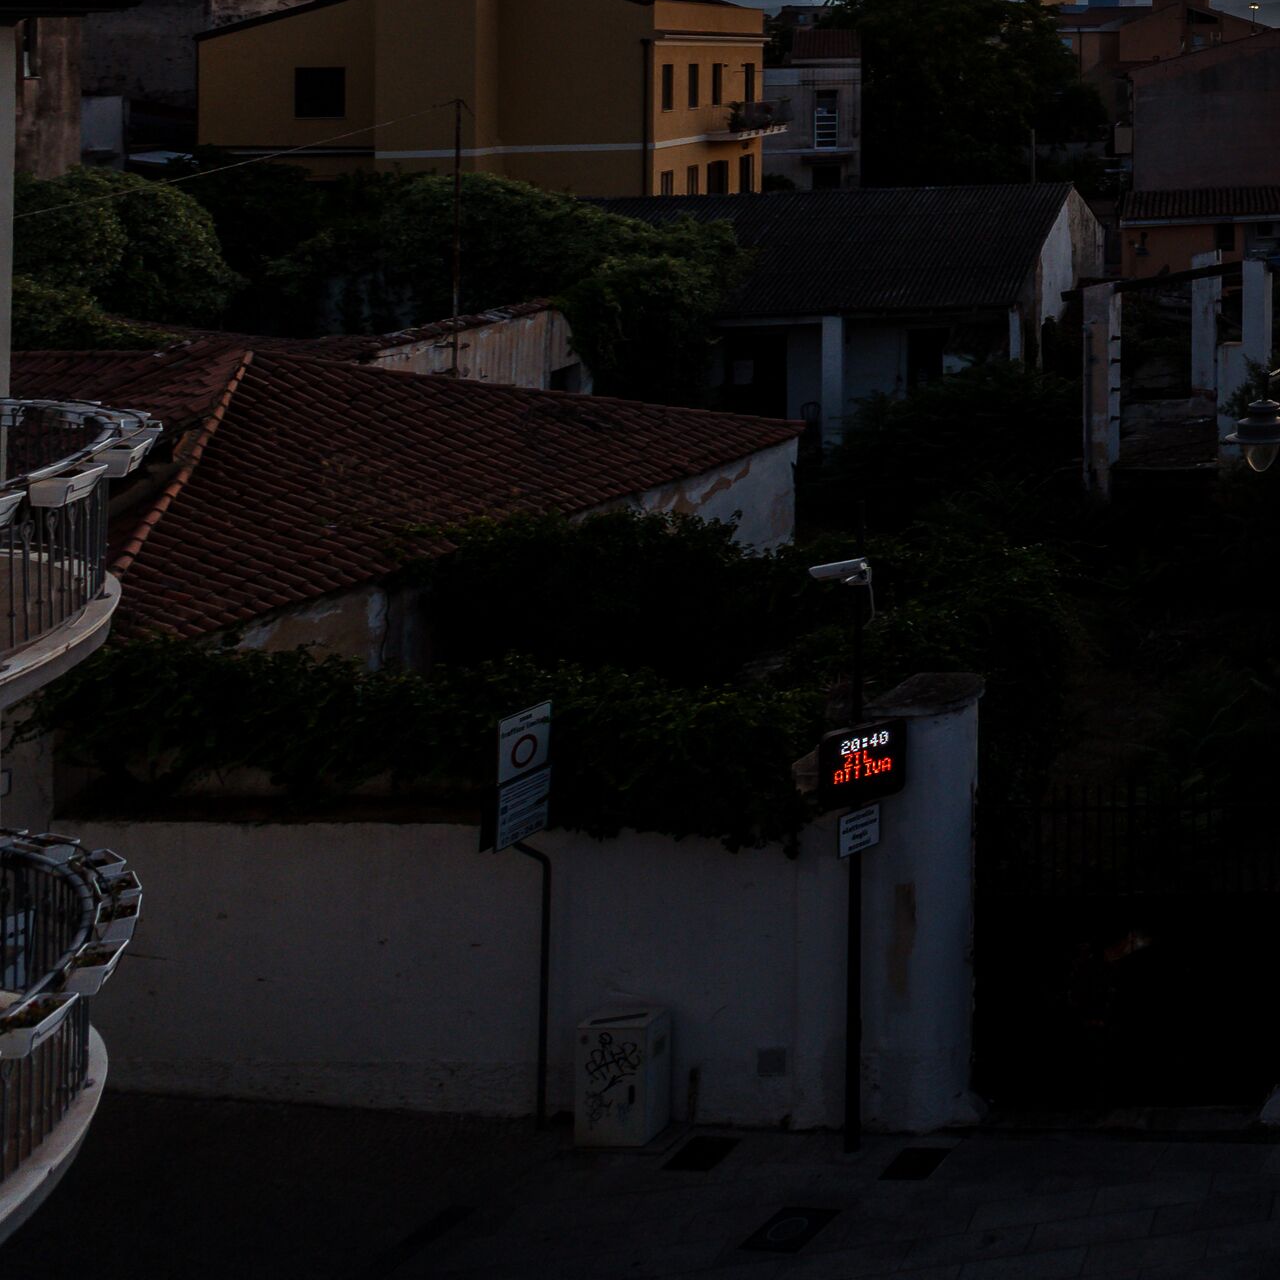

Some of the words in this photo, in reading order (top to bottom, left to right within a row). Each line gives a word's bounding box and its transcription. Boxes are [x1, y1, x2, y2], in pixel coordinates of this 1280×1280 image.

[840, 730, 889, 756] 20:40
[833, 757, 892, 785] ATTIVA
[844, 749, 873, 769] ZTL
